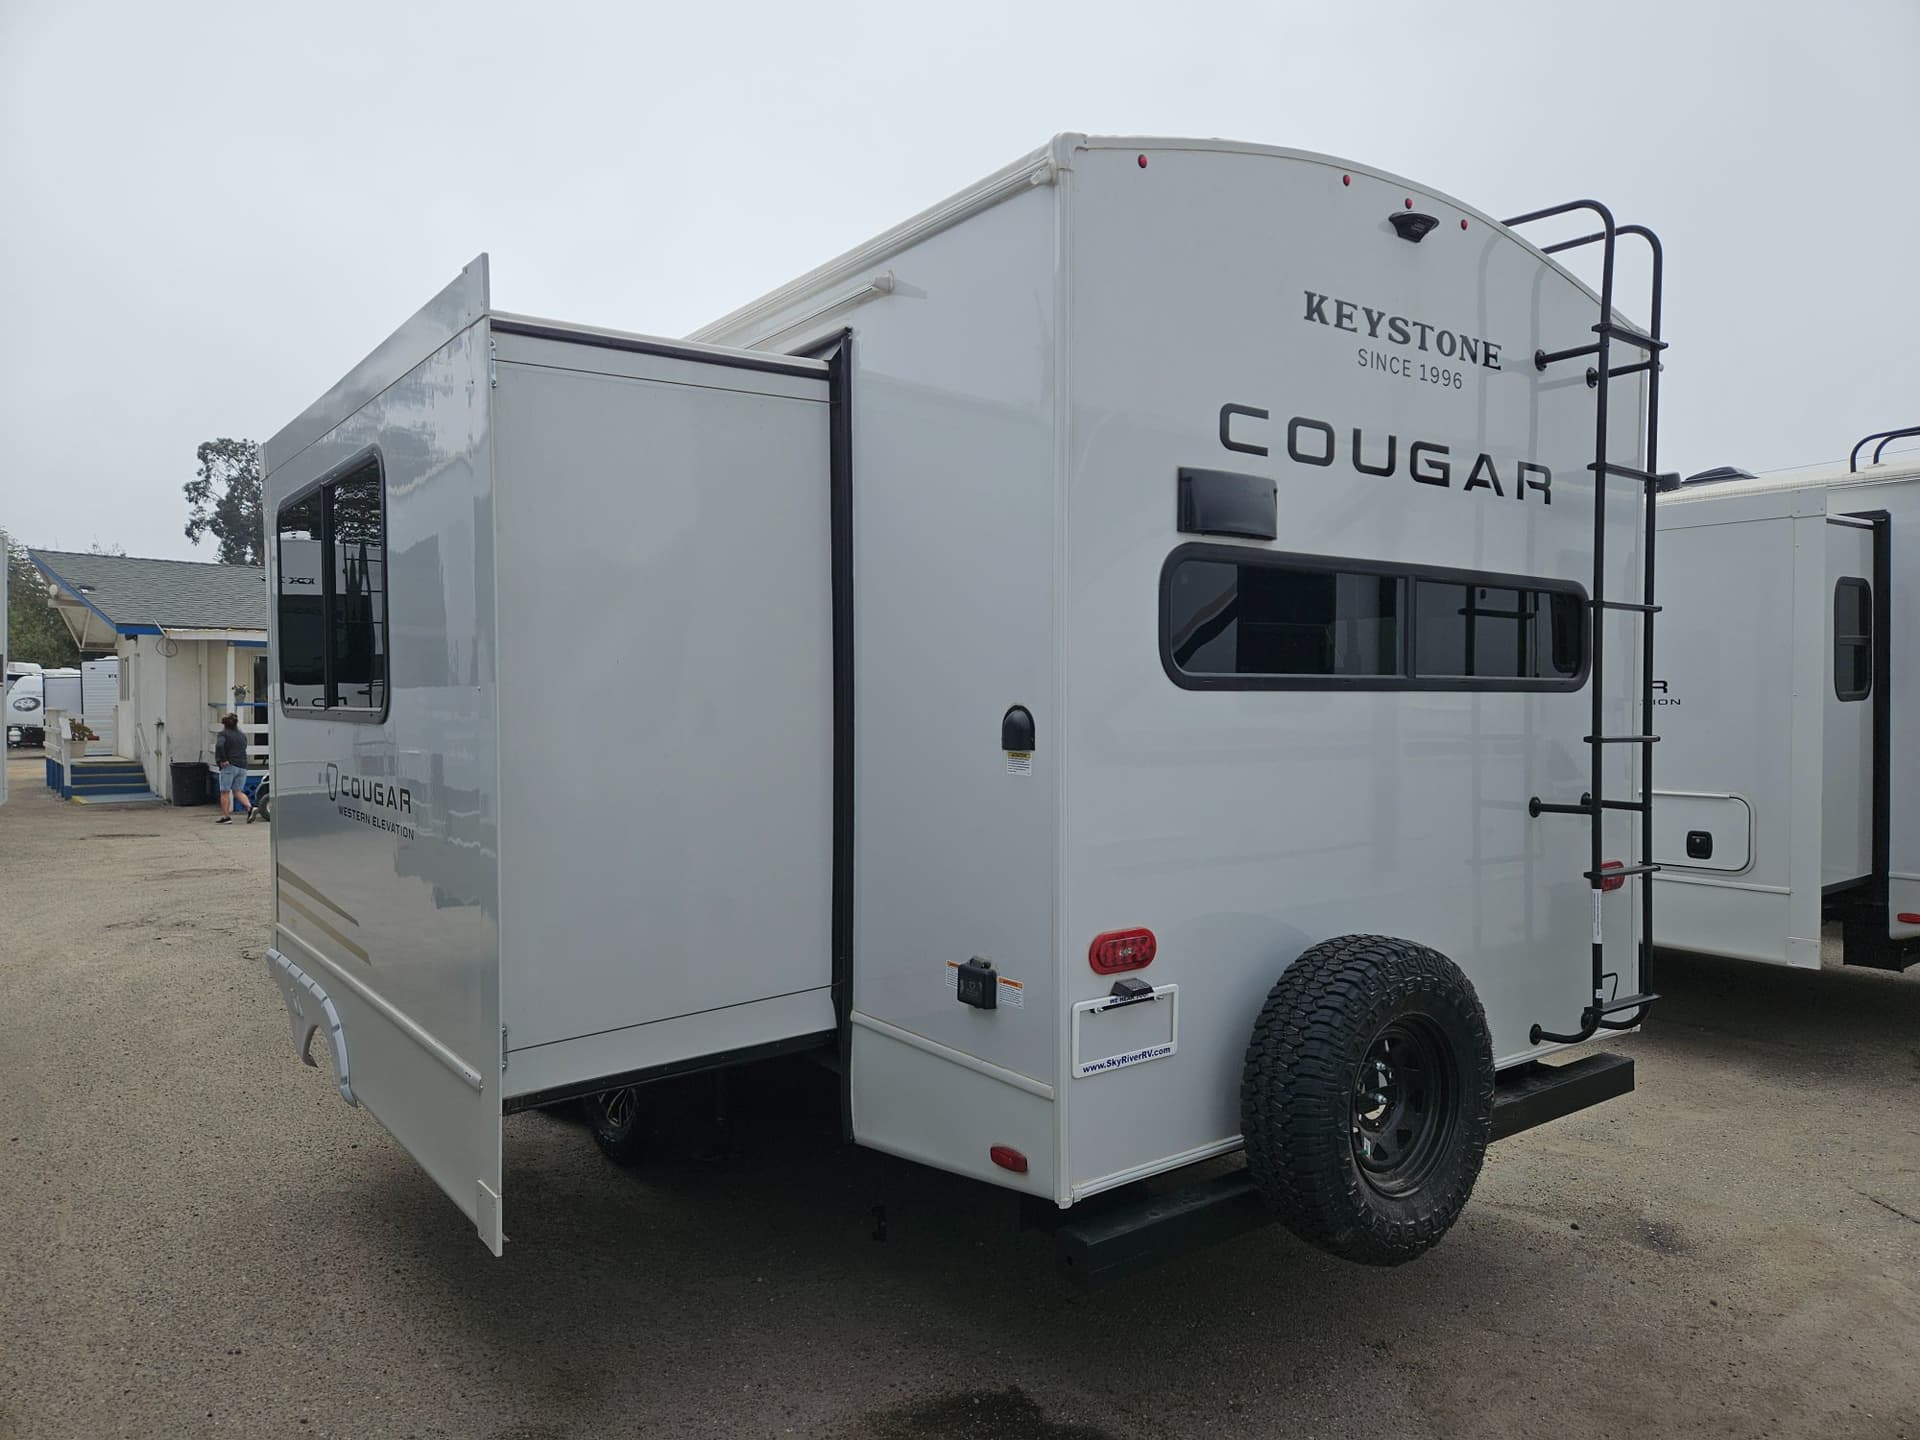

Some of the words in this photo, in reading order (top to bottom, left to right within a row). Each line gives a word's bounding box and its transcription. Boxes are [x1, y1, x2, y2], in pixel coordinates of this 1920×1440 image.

[1303, 290, 1502, 370] KEYSTONE
[1358, 348, 1412, 378] SINCE
[1419, 363, 1463, 390] 1996
[1219, 402, 1552, 505] COUGAR
[341, 775, 411, 815] COUGAR
[338, 806, 370, 824] WESTERN
[372, 815, 414, 840] ELEVATION
[1082, 1046, 1171, 1073] www.SkyRiverRV.com
